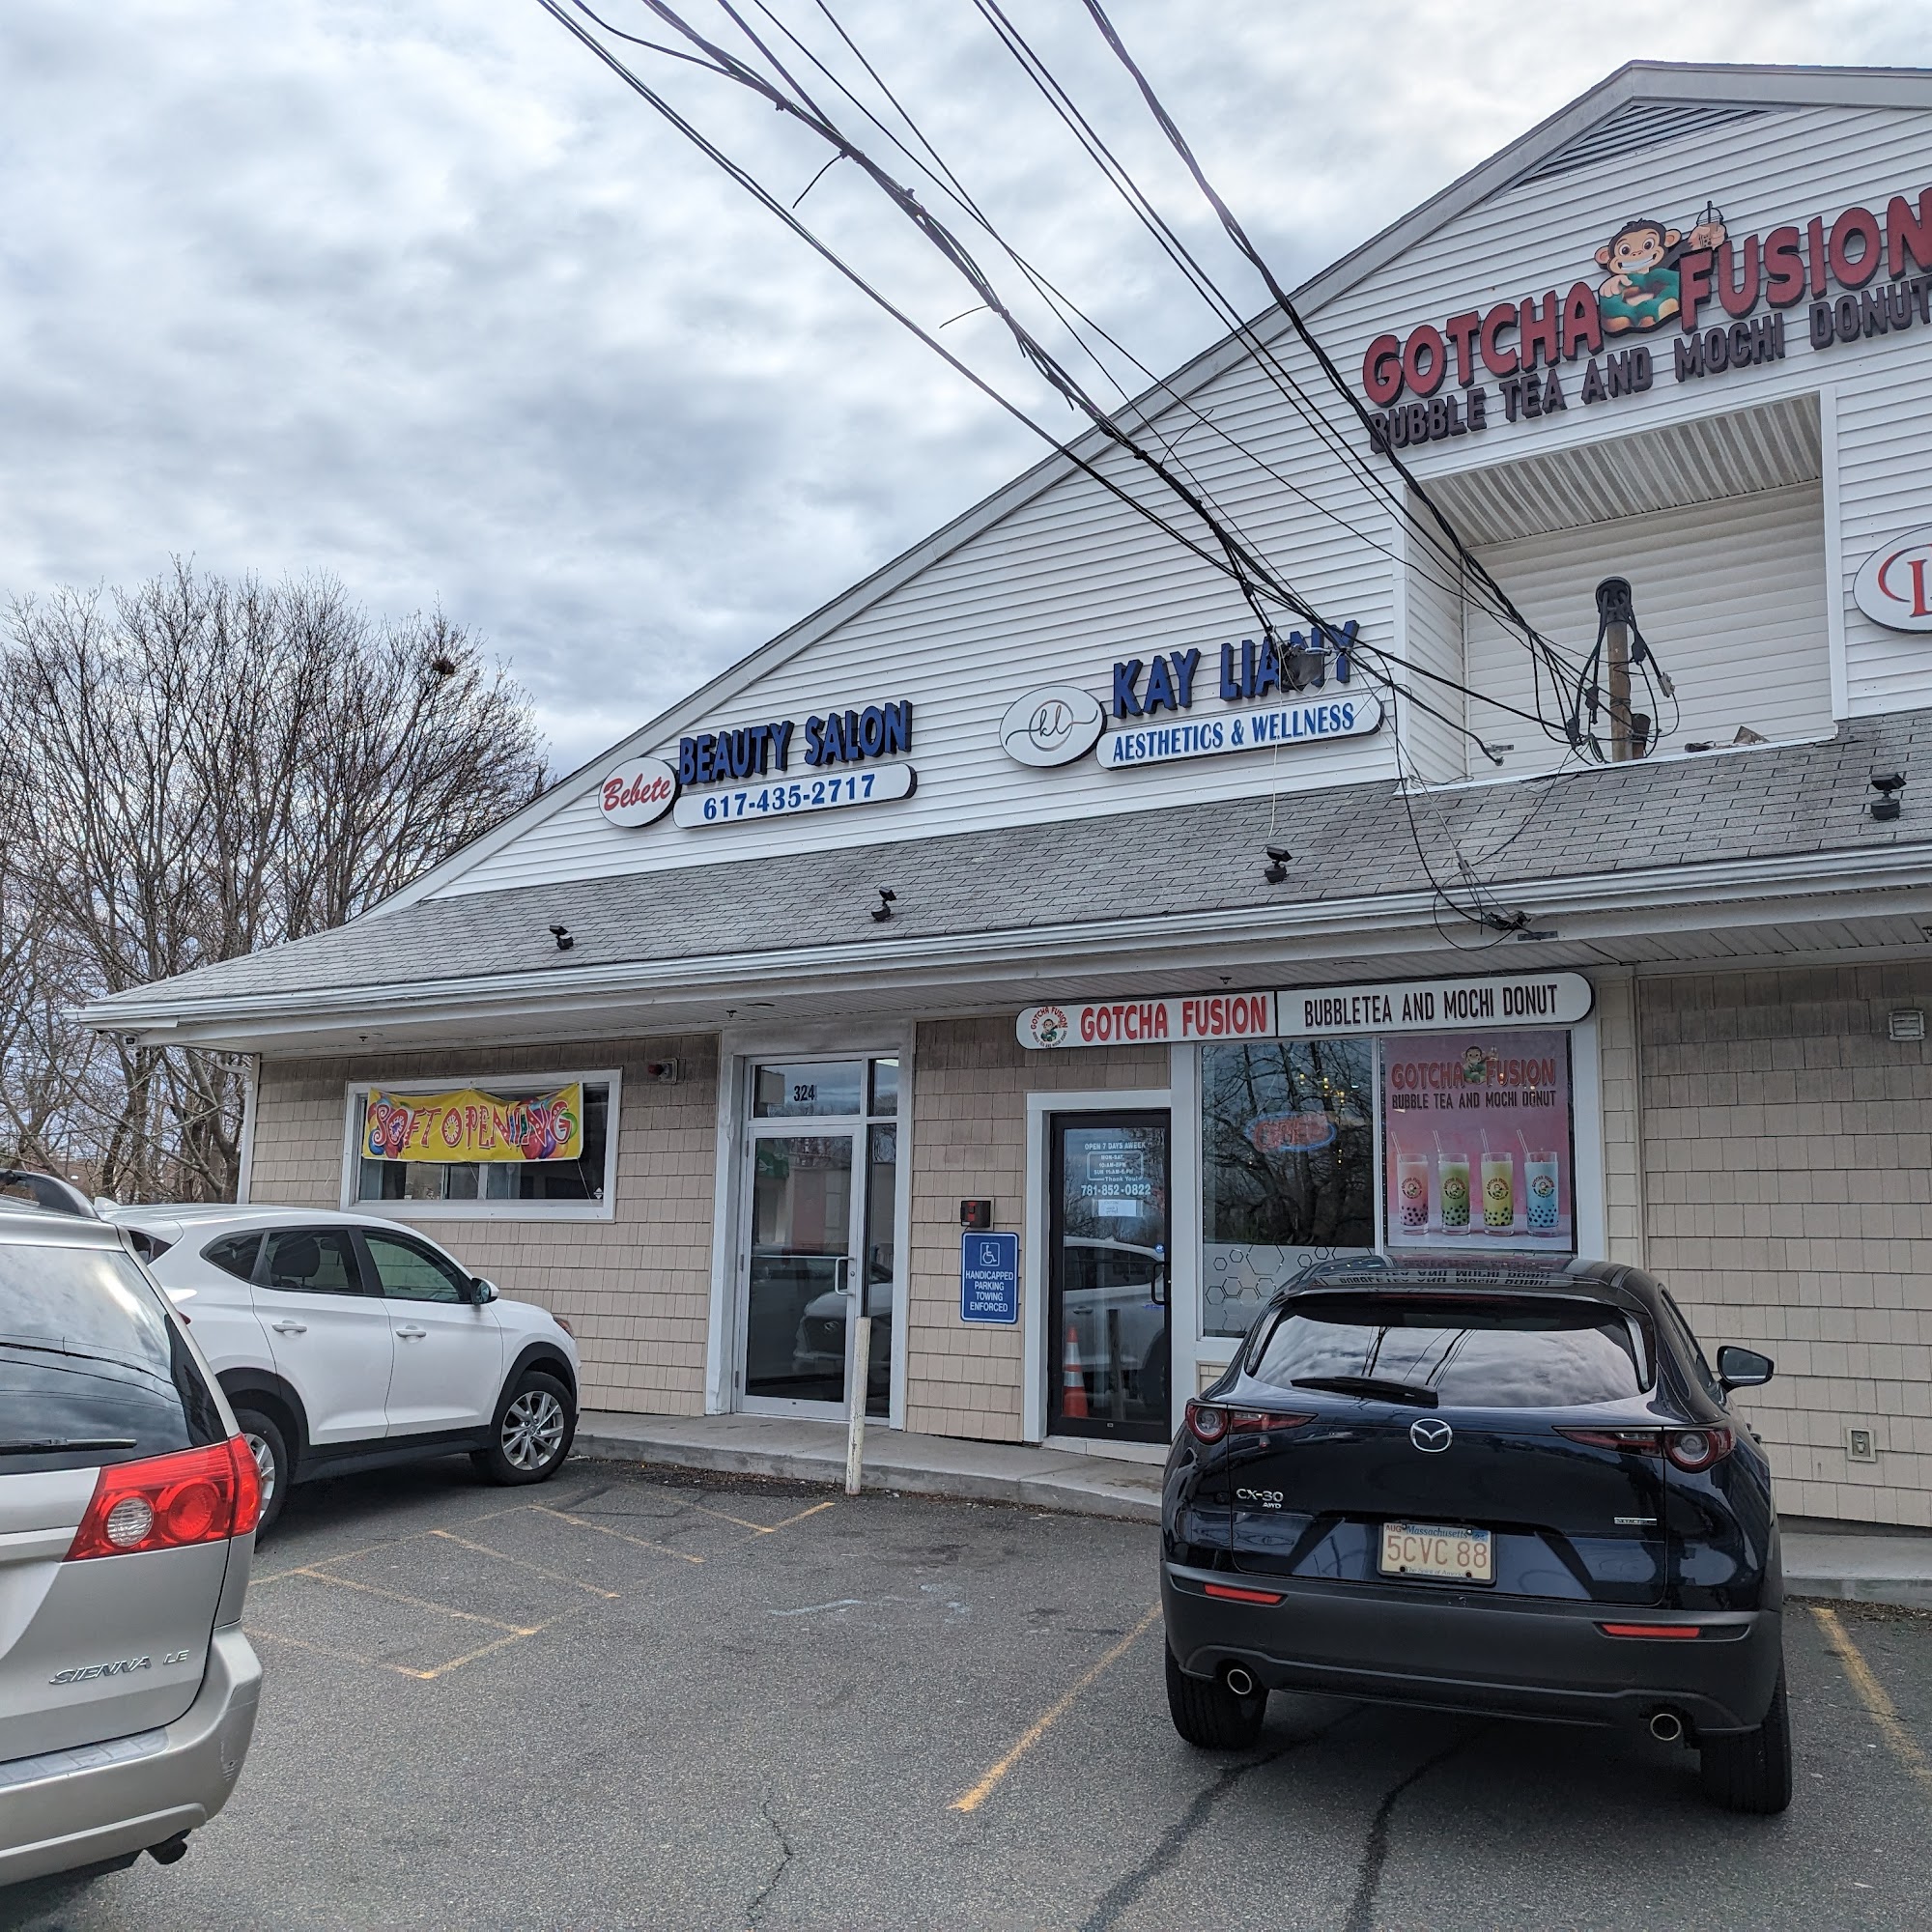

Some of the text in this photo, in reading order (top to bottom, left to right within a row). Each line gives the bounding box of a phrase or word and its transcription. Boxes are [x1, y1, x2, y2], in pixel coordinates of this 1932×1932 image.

[1363, 186, 1932, 408] GOTCHA FUSION
[1370, 274, 1932, 454] BUBBLE TEA AND MOCHI DONUT
[1113, 648, 1201, 719] KAY
[679, 699, 913, 785] BEAUTY SALON
[1113, 702, 1354, 763] AESTHETICS & WELLNESS
[603, 773, 670, 811] Bebete
[703, 774, 875, 821] 617-435-2717
[1031, 1007, 1068, 1030] GOTCHA FUSION
[1080, 1003, 1169, 1042] GOTCHA
[1182, 996, 1267, 1037] FUSION
[1305, 984, 1557, 1027] BUBBLETEA AND MOCHI DONUT
[1391, 1058, 1556, 1090] GOTCHA FUSION
[793, 1084, 816, 1101] 324
[1392, 1090, 1556, 1110] BUBBLE TEA AND MOCHI DONUT
[373, 1100, 573, 1151] SOFT OPENING
[965, 1270, 1014, 1281] HANDICAPPED
[974, 1281, 1005, 1291] PARKING
[969, 1301, 1009, 1312] ENFORCED
[976, 1292, 1003, 1301] TOWING
[1236, 1488, 1284, 1502] CX-30
[1385, 1524, 1402, 1533] AUG
[1406, 1526, 1467, 1539] Massachusetts
[1387, 1535, 1488, 1568] 5CVC 88
[48, 1649, 190, 1685] SIENNA LE
